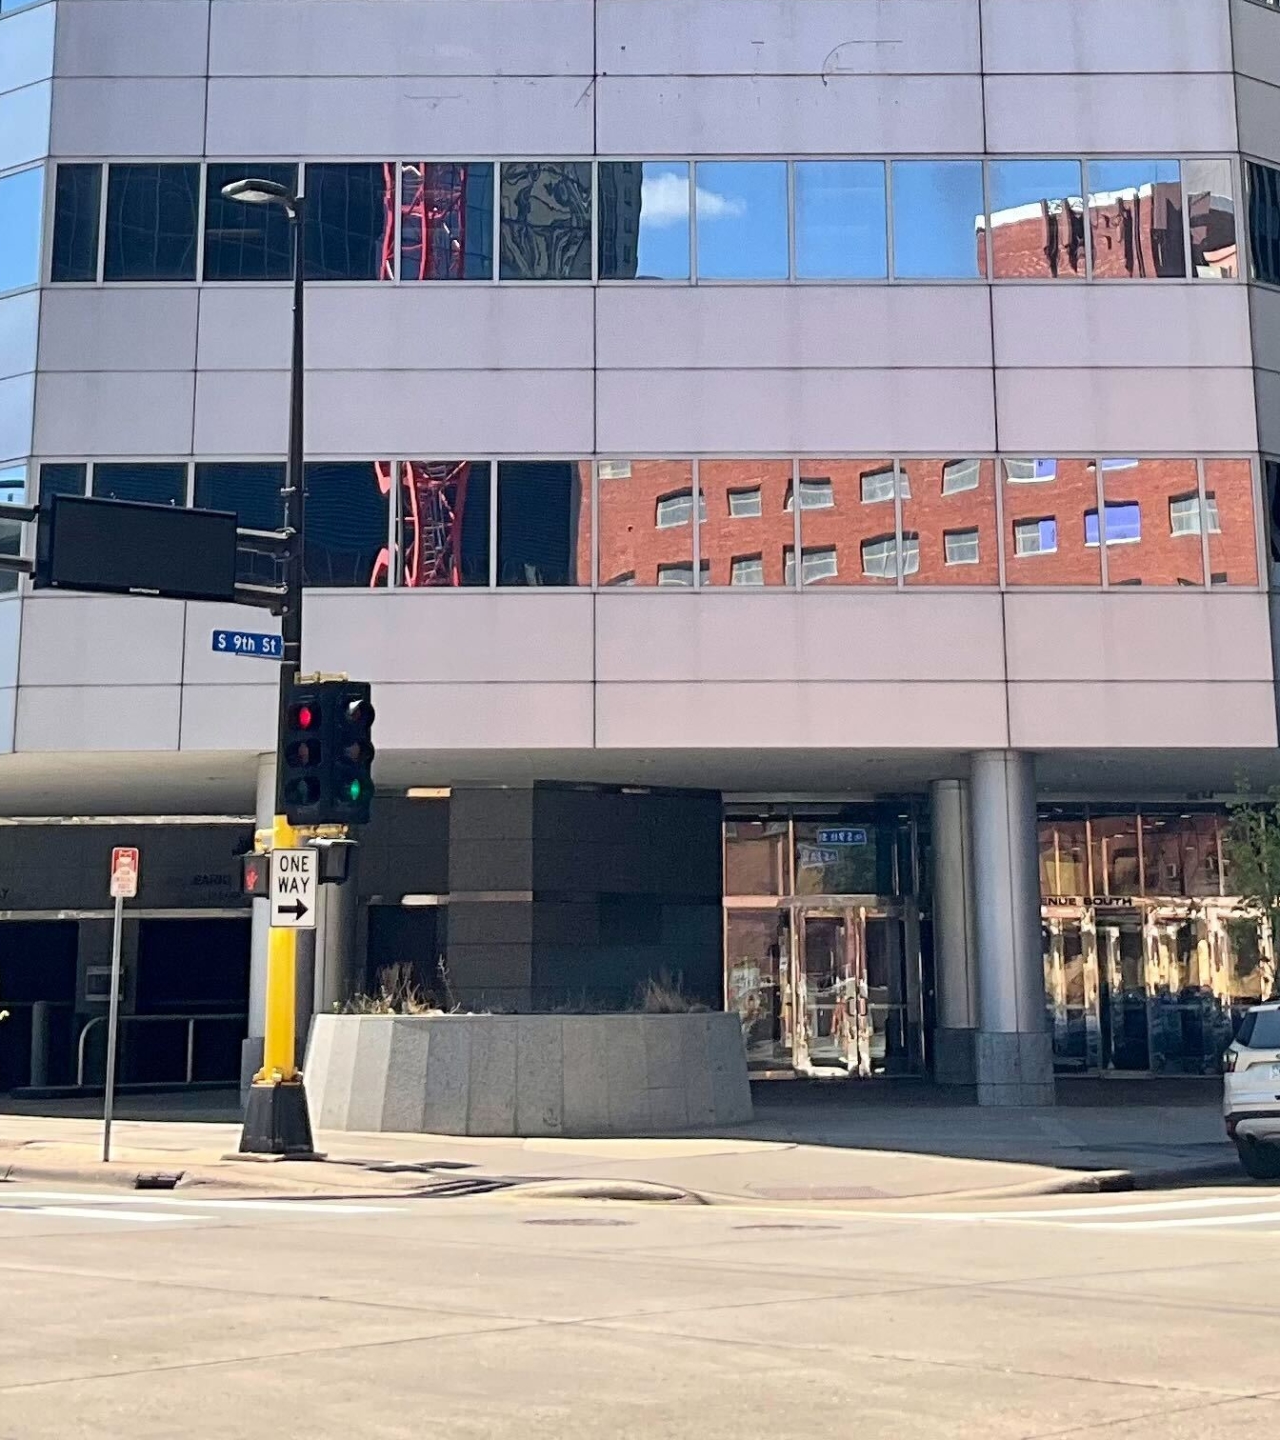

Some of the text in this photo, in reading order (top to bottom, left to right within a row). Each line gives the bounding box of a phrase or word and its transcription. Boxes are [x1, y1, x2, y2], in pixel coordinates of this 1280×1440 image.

[218, 634, 276, 653] S 9th St
[280, 855, 309, 872] ONE
[278, 876, 310, 894] WAY
[1083, 897, 1132, 906] SOUTH
